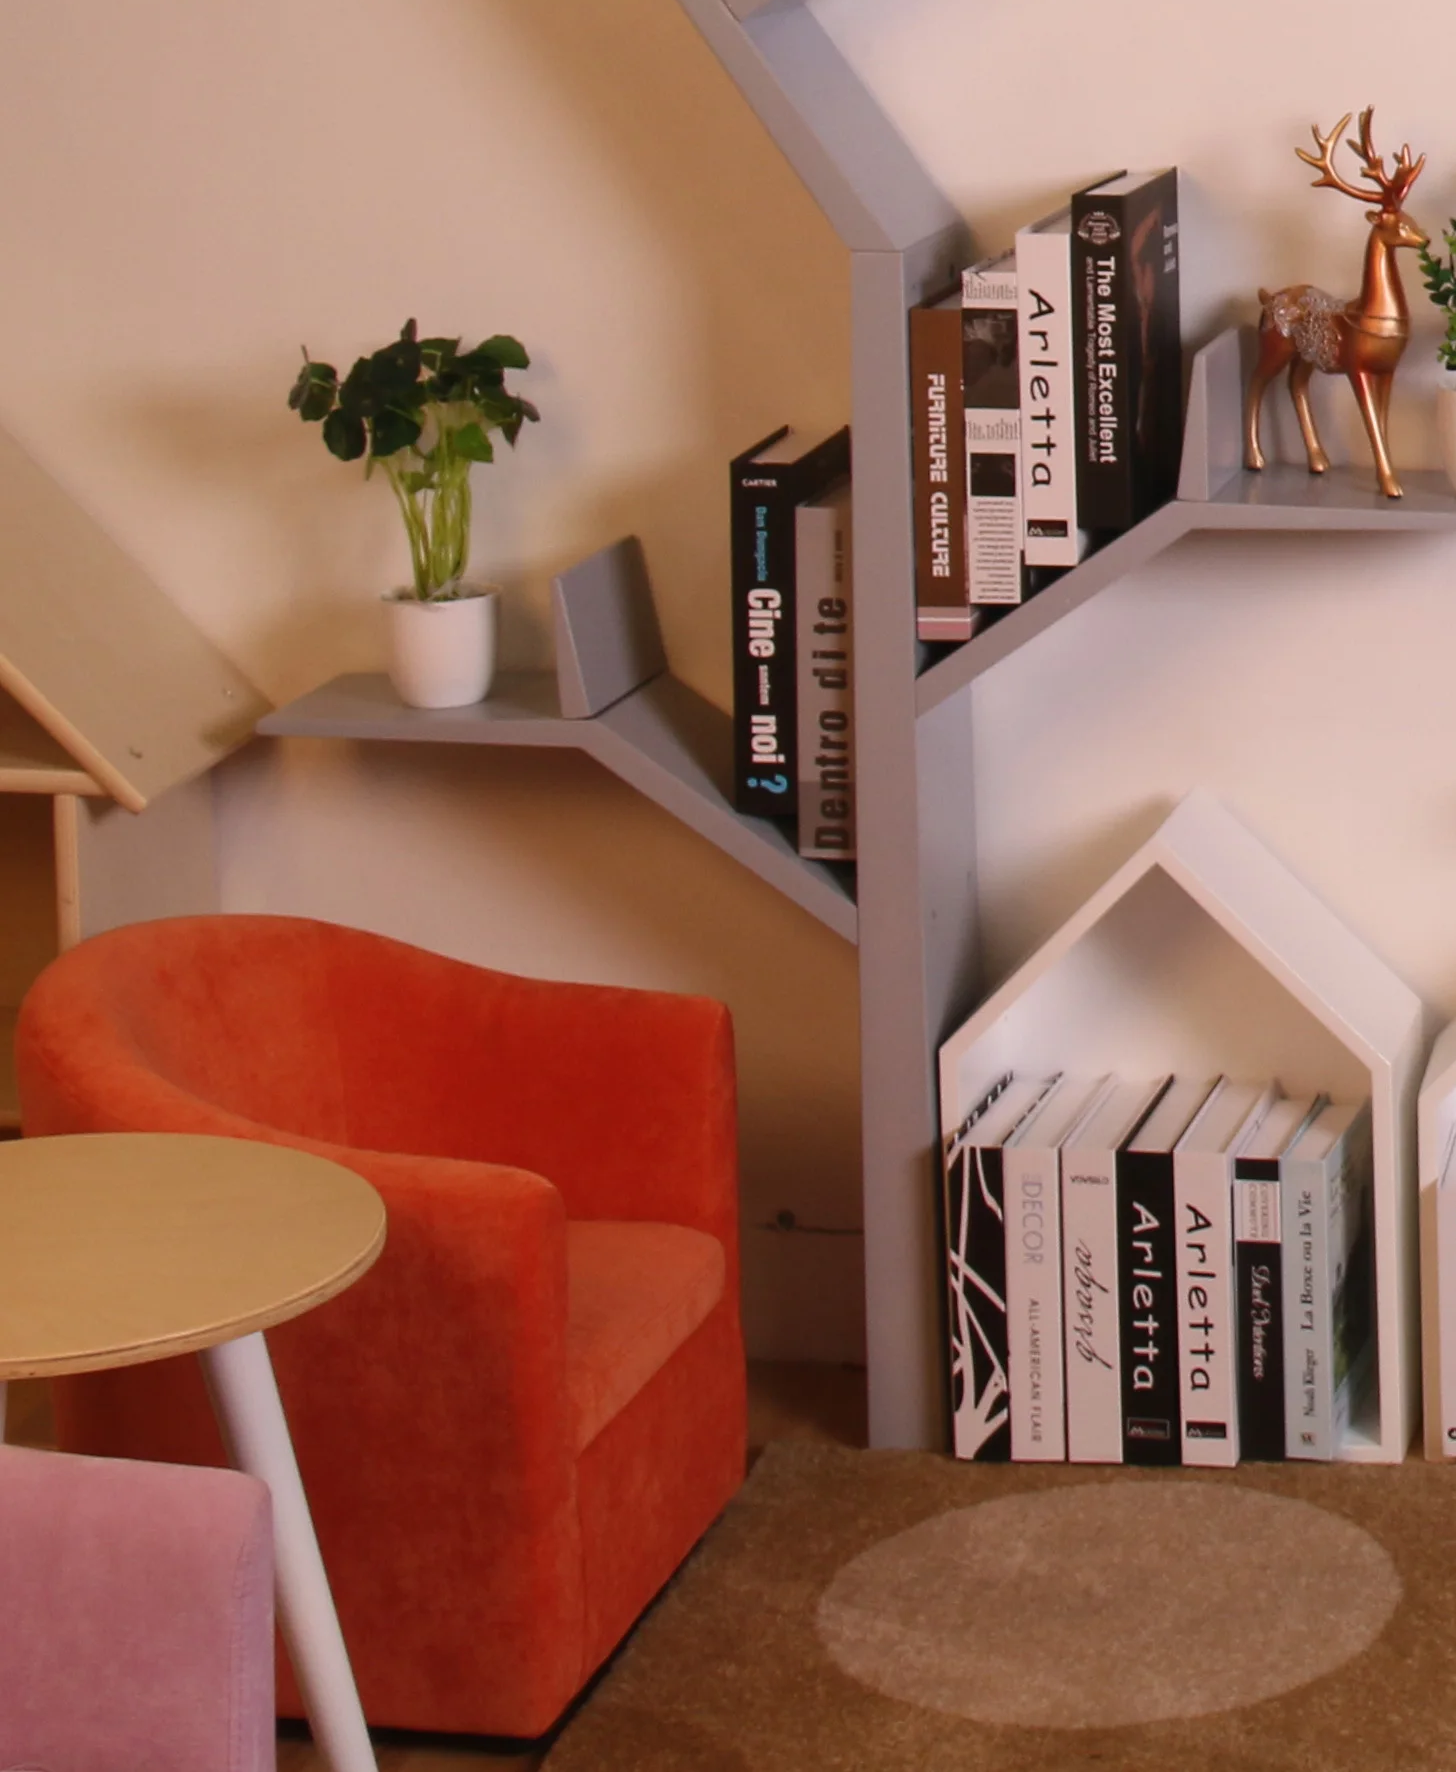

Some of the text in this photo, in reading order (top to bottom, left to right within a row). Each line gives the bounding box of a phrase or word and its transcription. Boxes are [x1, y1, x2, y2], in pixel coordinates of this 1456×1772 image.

[1096, 257, 1115, 296] The
[1097, 304, 1115, 356] Most
[1028, 288, 1060, 489] Arletta
[1098, 364, 1118, 463] Excellent
[742, 478, 777, 488] CARTIER
[927, 373, 951, 578] FURNITURE CULTURE
[747, 587, 786, 765] Cine noi
[813, 596, 848, 852] Dentro di te
[1022, 1180, 1044, 1265] DECOR
[1299, 1190, 1314, 1332] La Boxe ou la Vie
[1131, 1201, 1164, 1391] Arletta
[1186, 1203, 1216, 1392] Arletta
[1028, 1298, 1042, 1443] ALL-AMERICAN FLAIR
